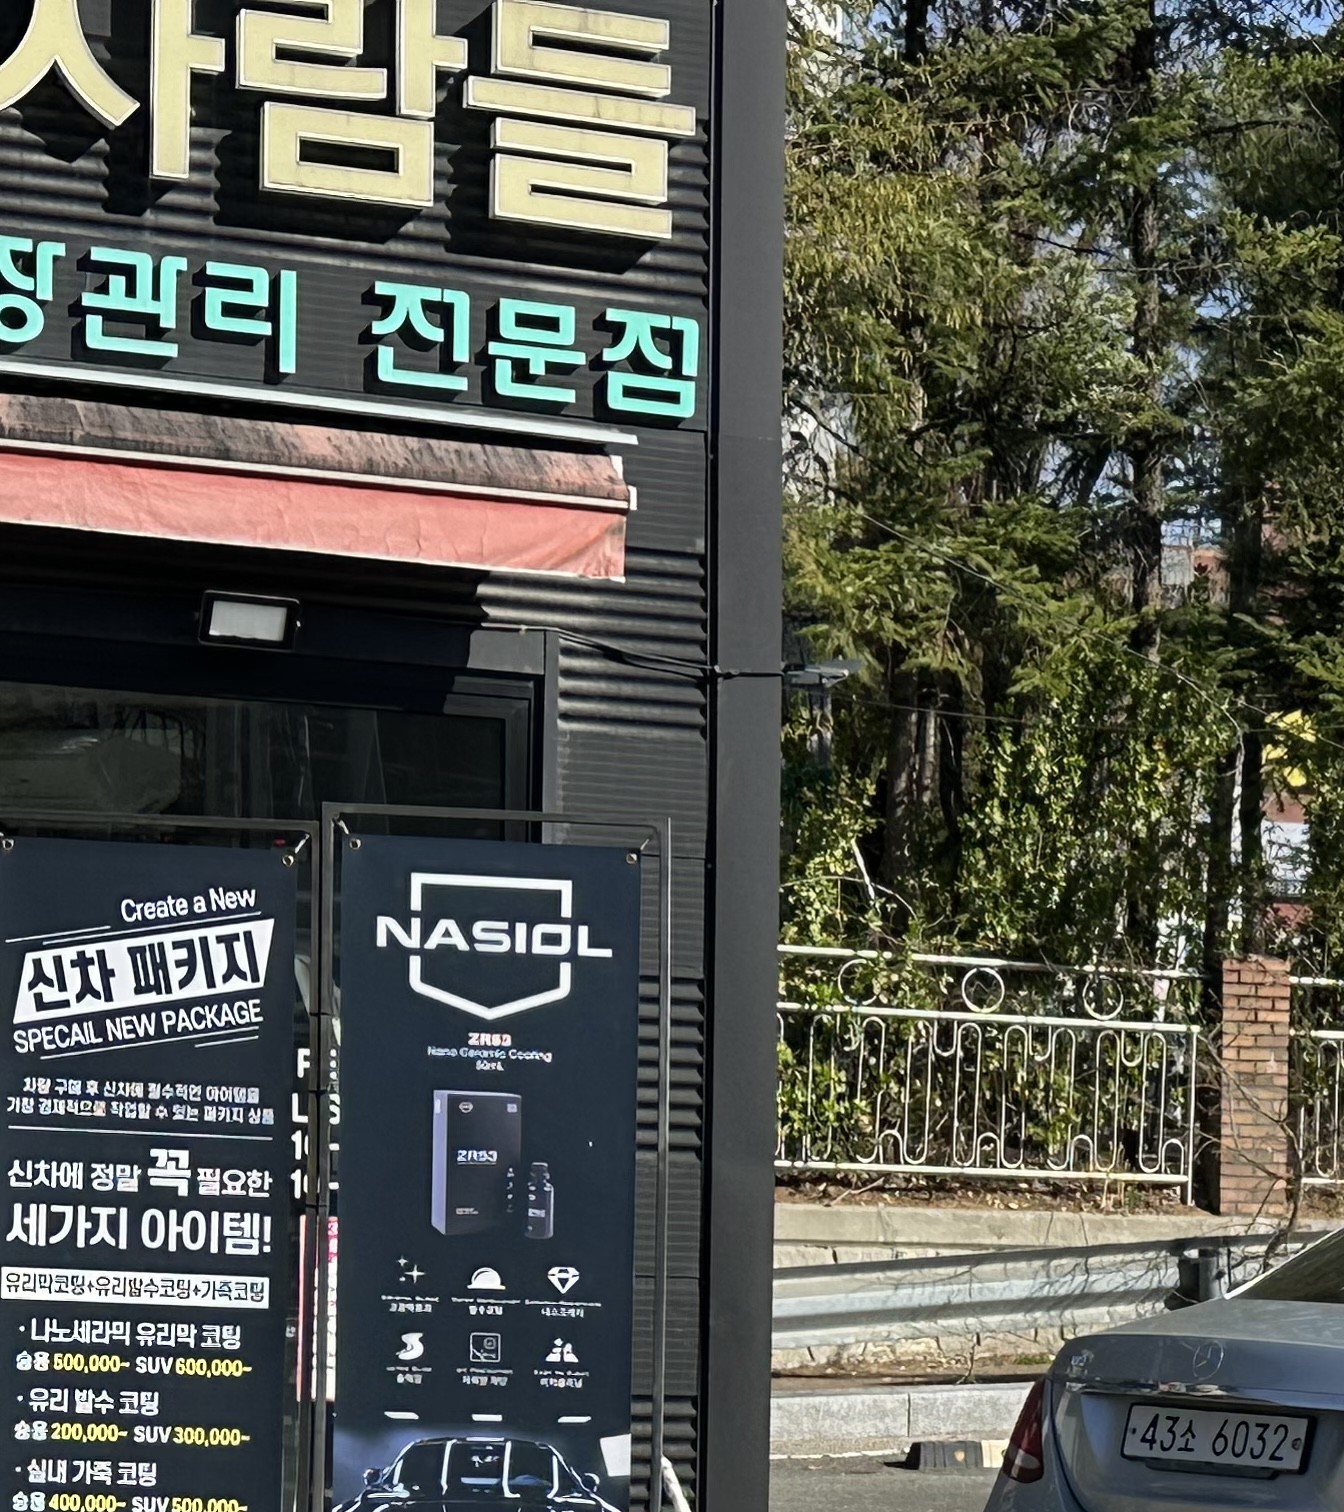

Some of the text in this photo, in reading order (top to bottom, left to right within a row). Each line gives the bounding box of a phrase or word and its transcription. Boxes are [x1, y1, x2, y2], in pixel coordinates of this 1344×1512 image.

[0, 0, 696, 239] 사람들
[370, 280, 699, 419] 전문점
[121, 887, 257, 922] Create a New
[375, 915, 614, 959] NASIOL
[28, 931, 261, 1012] 신차 패키지
[13, 999, 264, 1054] SPECAIL NEW PACKAGE
[8, 1160, 84, 1190] 신차에
[90, 1163, 142, 1192] 정말
[147, 1148, 192, 1197] 꼭
[197, 1168, 273, 1198] 필요한
[6, 1203, 272, 1256] 세가지 아이템!
[136, 1321, 198, 1349] 유리막
[201, 1325, 242, 1350] 코팅
[136, 1356, 174, 1375] SUV
[29, 1387, 160, 1416] 유리 발수 코팅
[134, 1425, 172, 1444] SUV
[1139, 1412, 1289, 1463] 43소 6032
[27, 1458, 157, 1487] 실내 가죽 코팅
